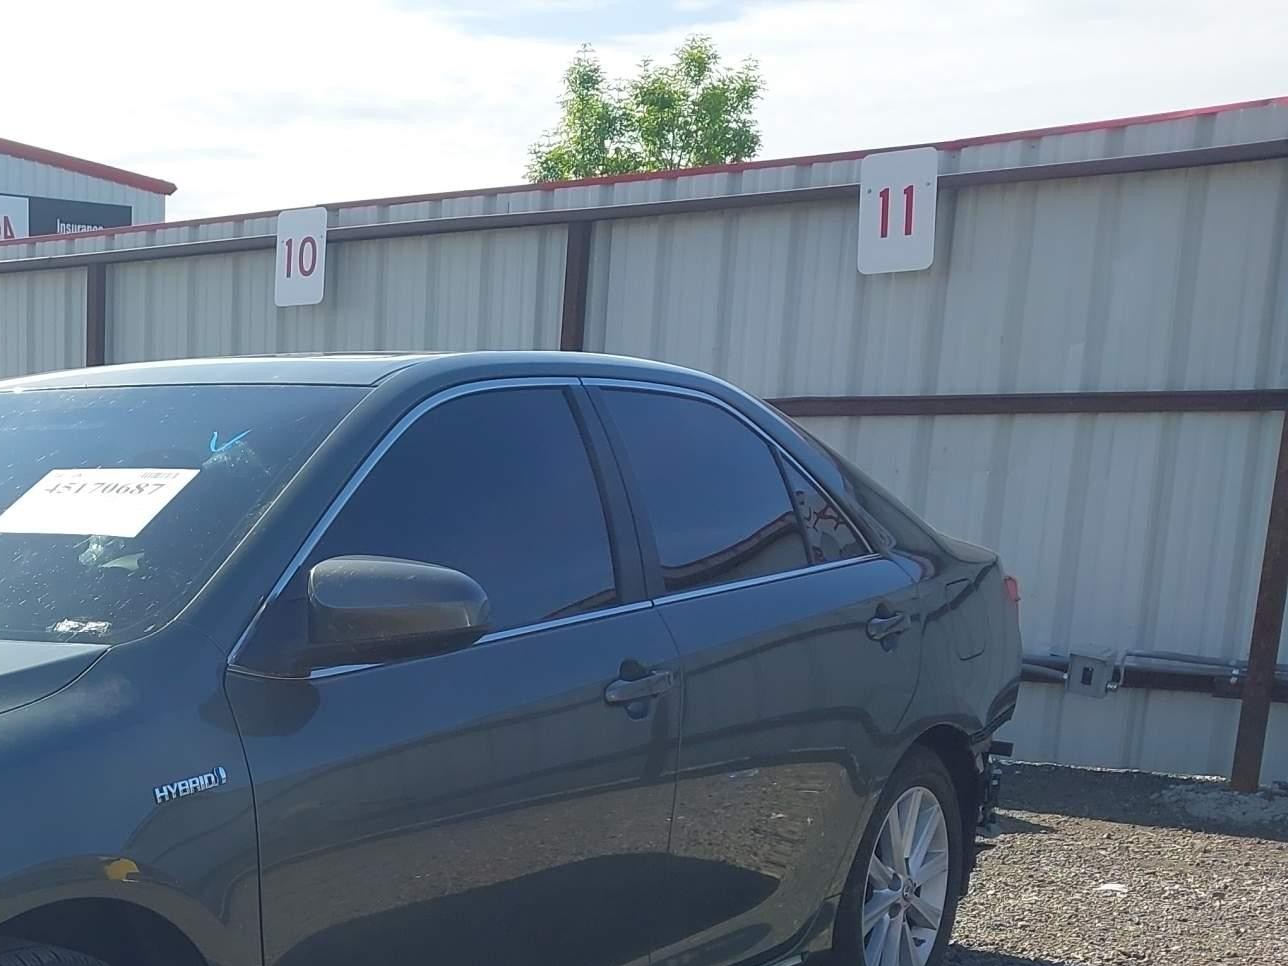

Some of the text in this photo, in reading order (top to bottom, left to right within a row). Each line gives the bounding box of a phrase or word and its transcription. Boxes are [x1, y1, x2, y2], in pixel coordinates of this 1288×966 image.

[879, 184, 913, 239] 11
[284, 236, 318, 279] 10
[44, 482, 167, 495] 45170687
[154, 772, 217, 804] HYBRID
